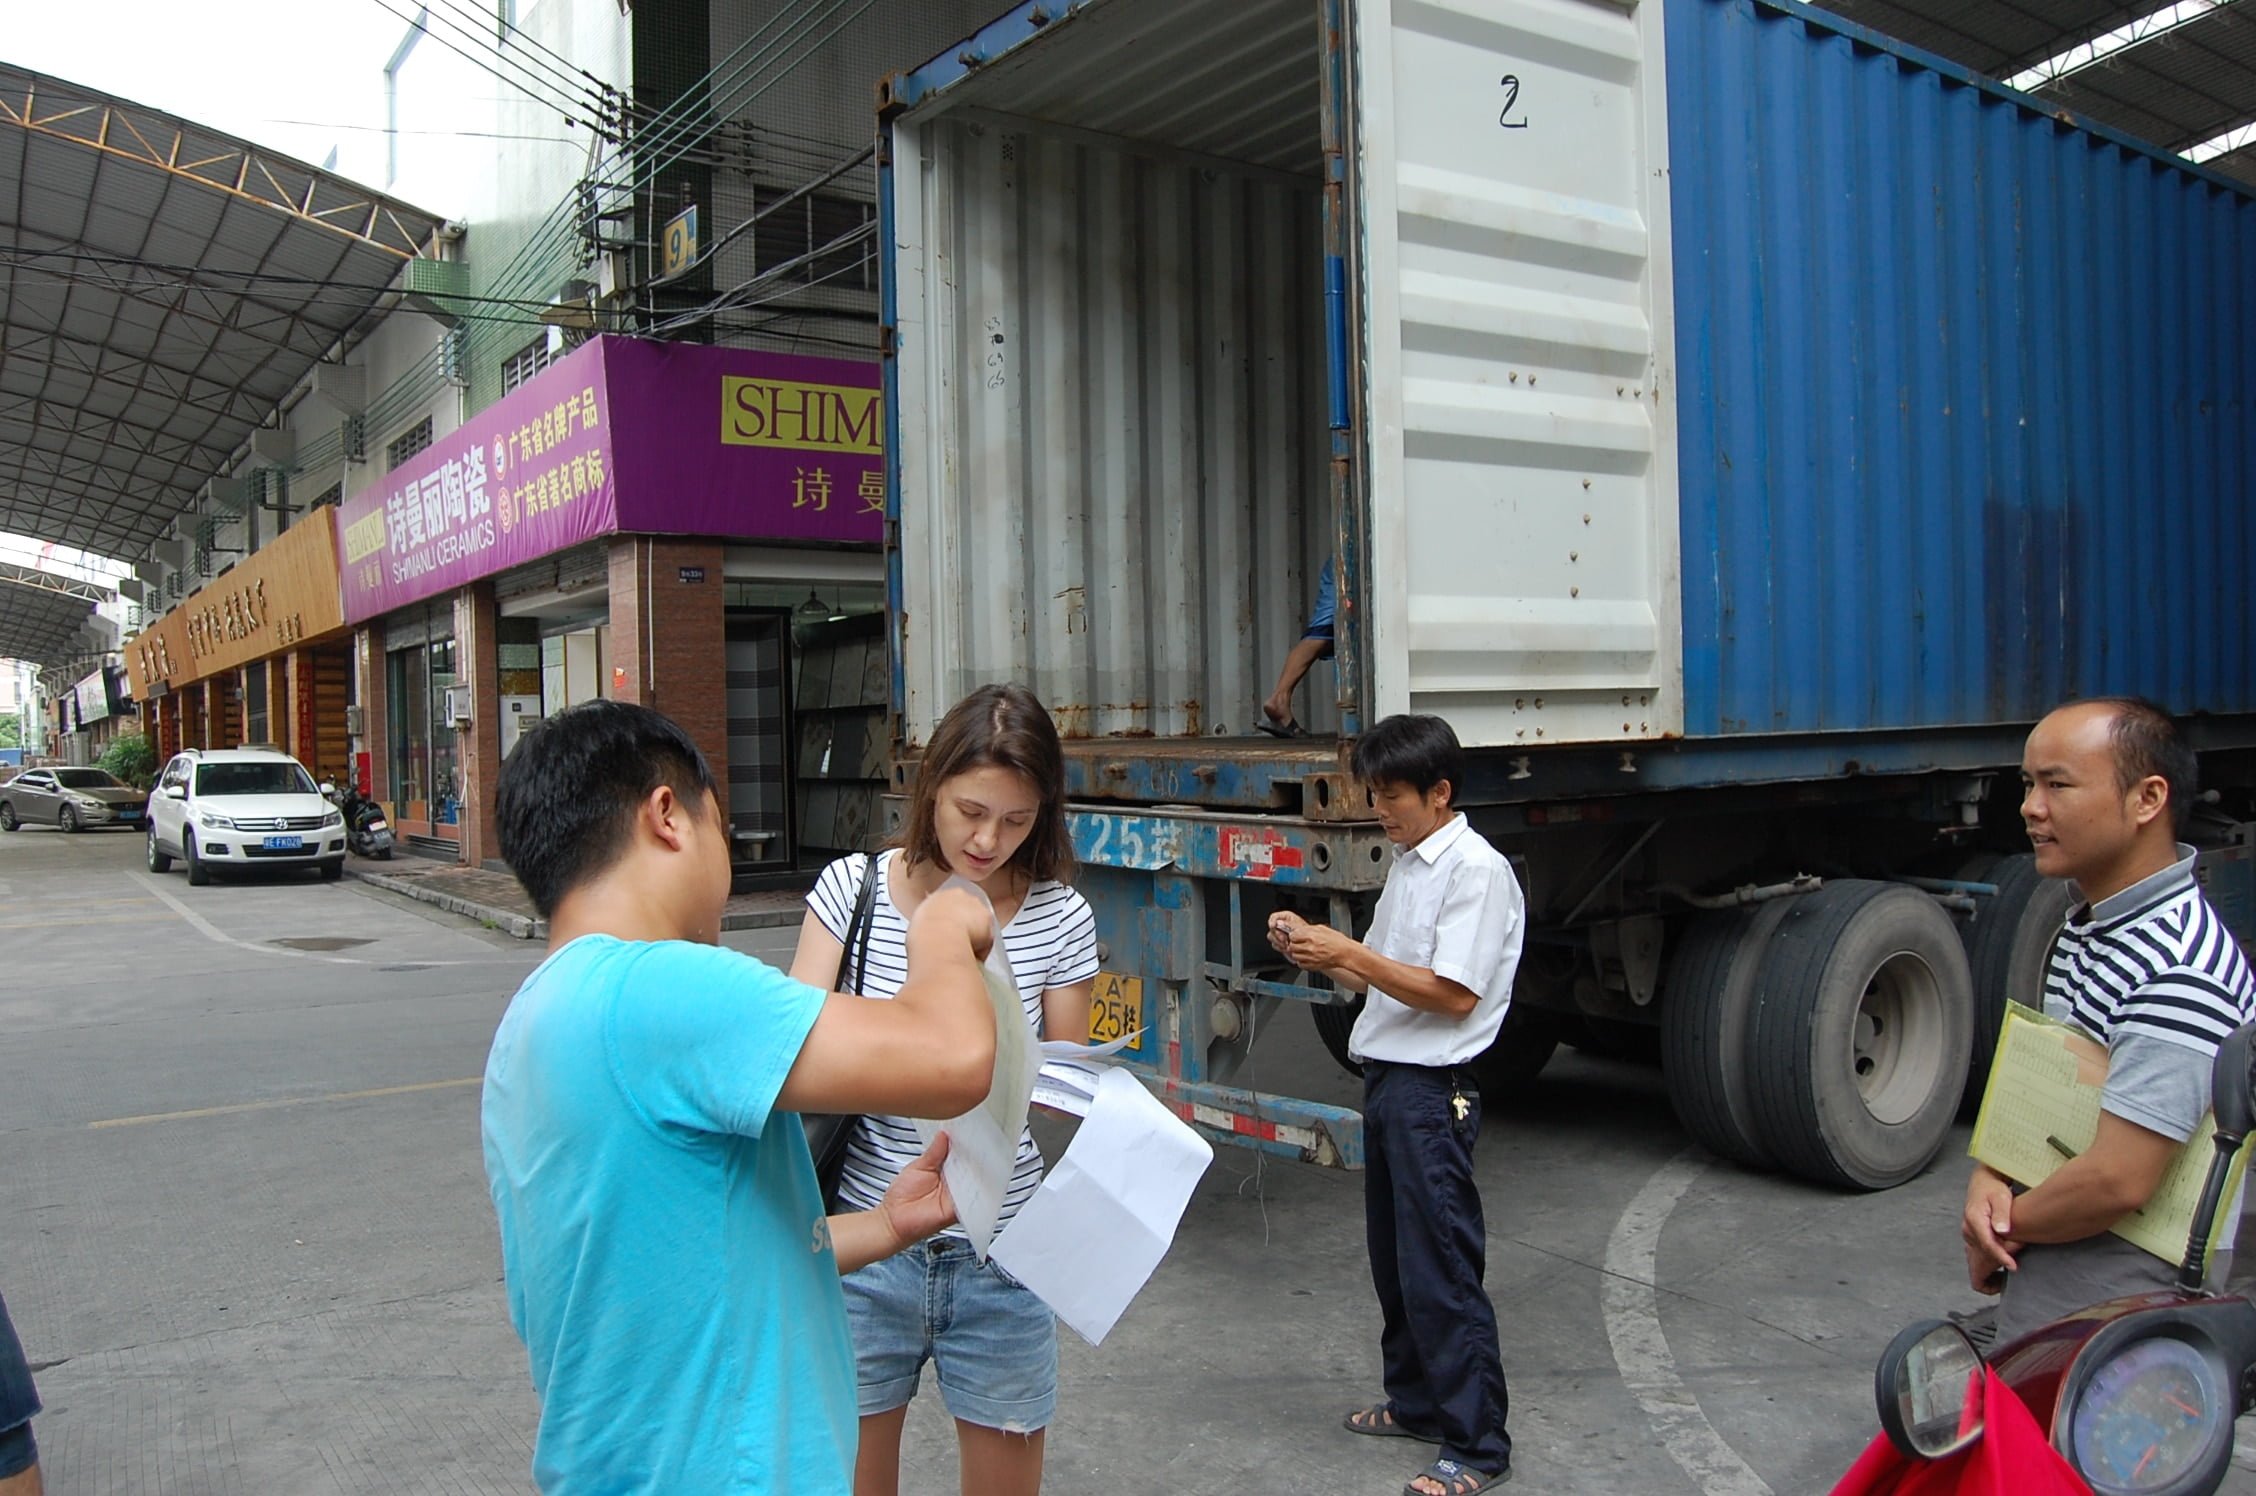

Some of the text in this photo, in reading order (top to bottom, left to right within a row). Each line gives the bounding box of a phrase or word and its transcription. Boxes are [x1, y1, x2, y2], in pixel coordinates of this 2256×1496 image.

[1500, 74, 1528, 128] 2
[671, 228, 681, 269] 9
[509, 386, 598, 469] 广东省名牌产品
[734, 383, 883, 447] SHIM
[386, 444, 490, 556] 诗曼丽陶瓷
[514, 448, 604, 523] 广东省著名商标
[392, 545, 438, 585] SHIMANLI
[436, 519, 495, 566] CERAMICS
[1106, 977, 1121, 998] A
